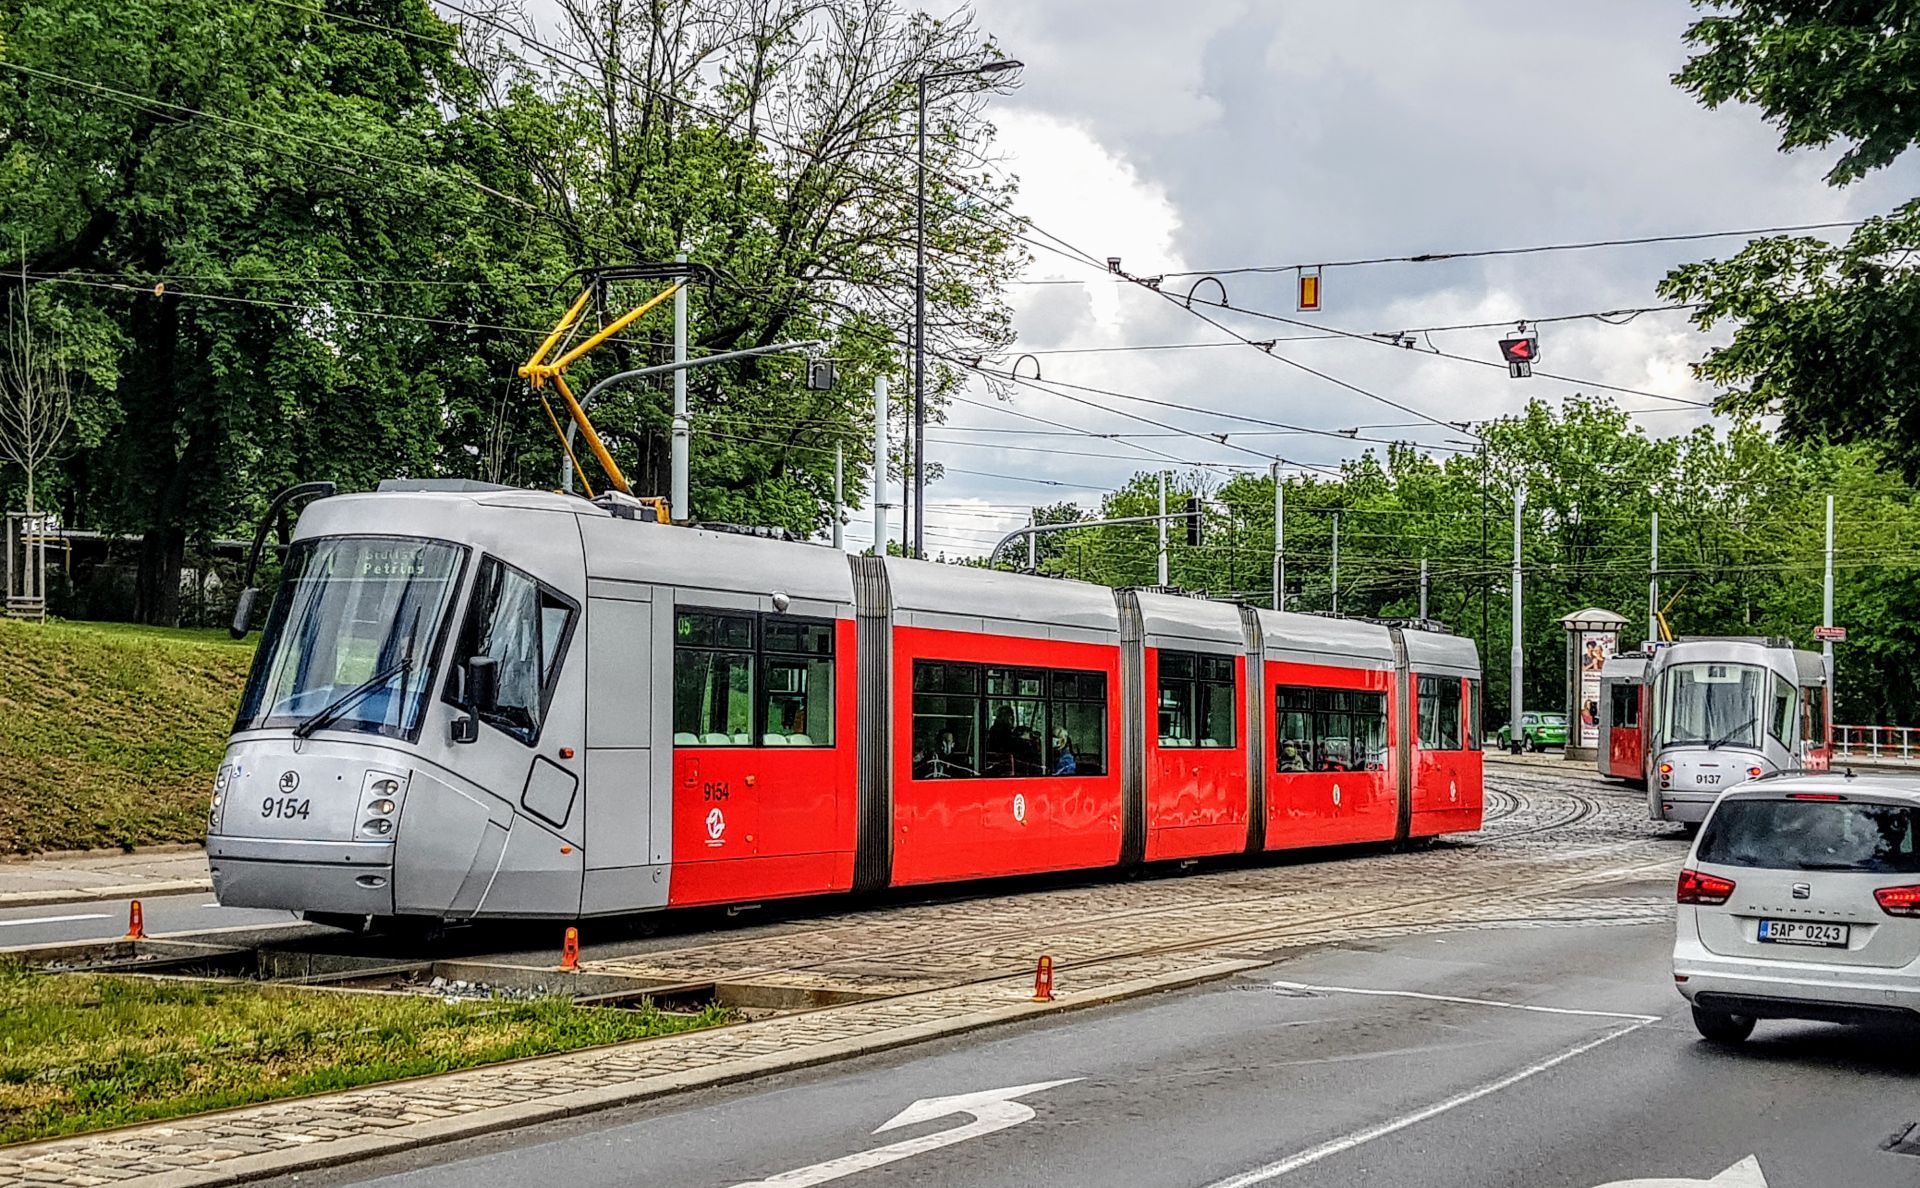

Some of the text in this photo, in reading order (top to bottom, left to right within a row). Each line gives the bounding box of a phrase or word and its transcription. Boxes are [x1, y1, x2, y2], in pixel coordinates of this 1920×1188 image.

[1696, 774, 1721, 784] 9137
[704, 782, 729, 801] 9154
[261, 797, 310, 820] 9154
[1770, 922, 1796, 938] 5AP
[1805, 925, 1841, 941] 0243
